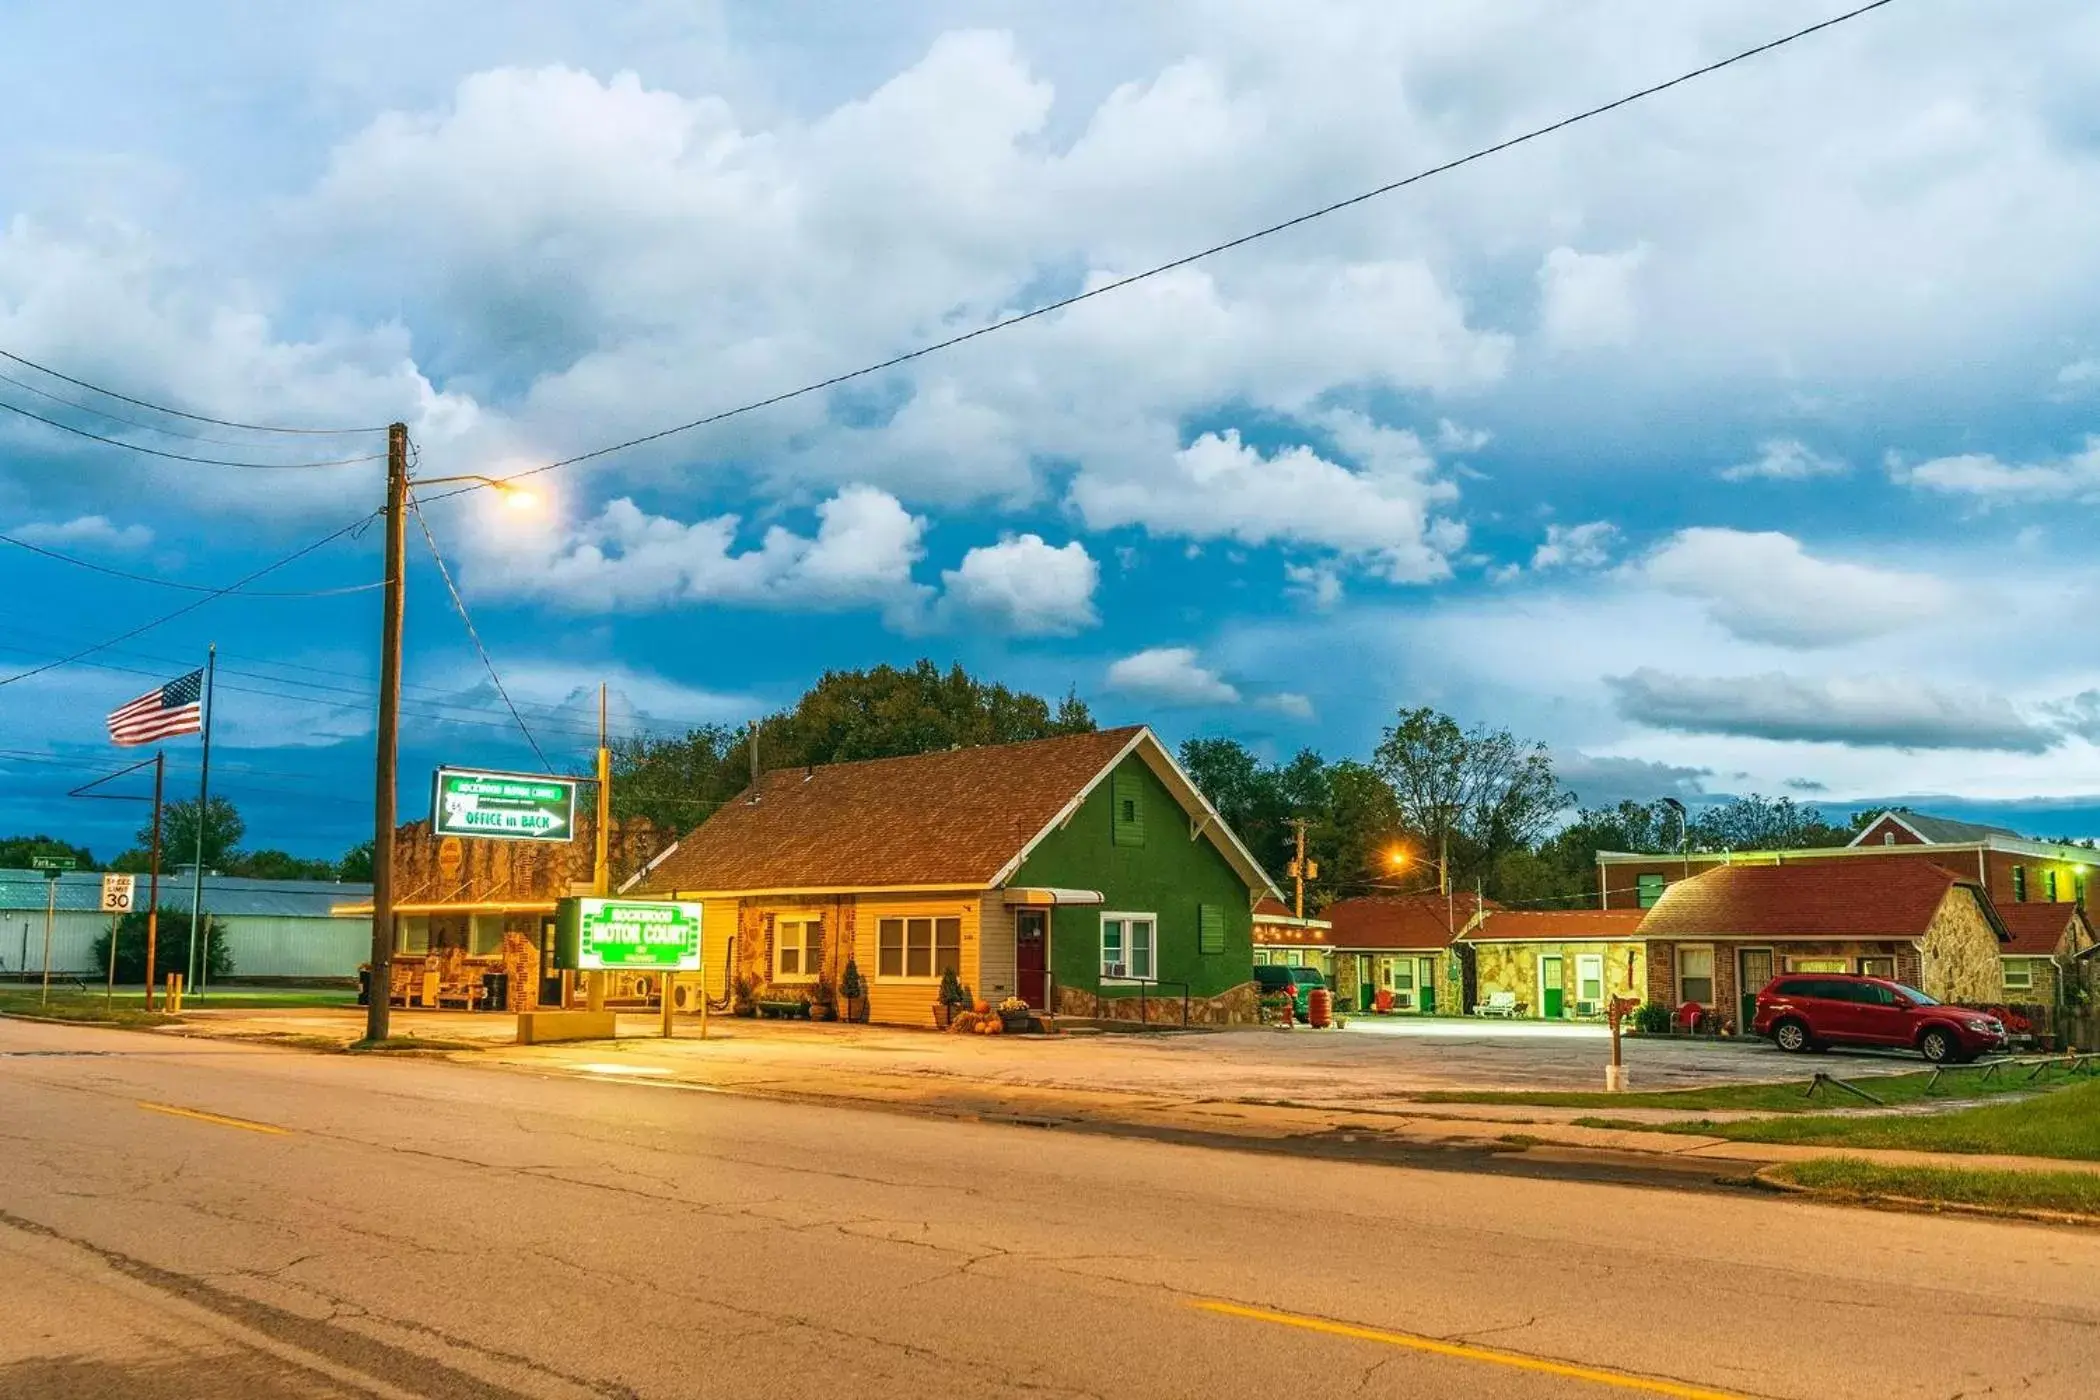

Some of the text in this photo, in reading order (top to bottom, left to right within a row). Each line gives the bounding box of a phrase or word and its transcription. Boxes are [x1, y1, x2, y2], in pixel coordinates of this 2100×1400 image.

[466, 812, 549, 828] OFFICE in BACK
[105, 893, 129, 908] 30
[593, 922, 689, 945] MOTOR COURT
